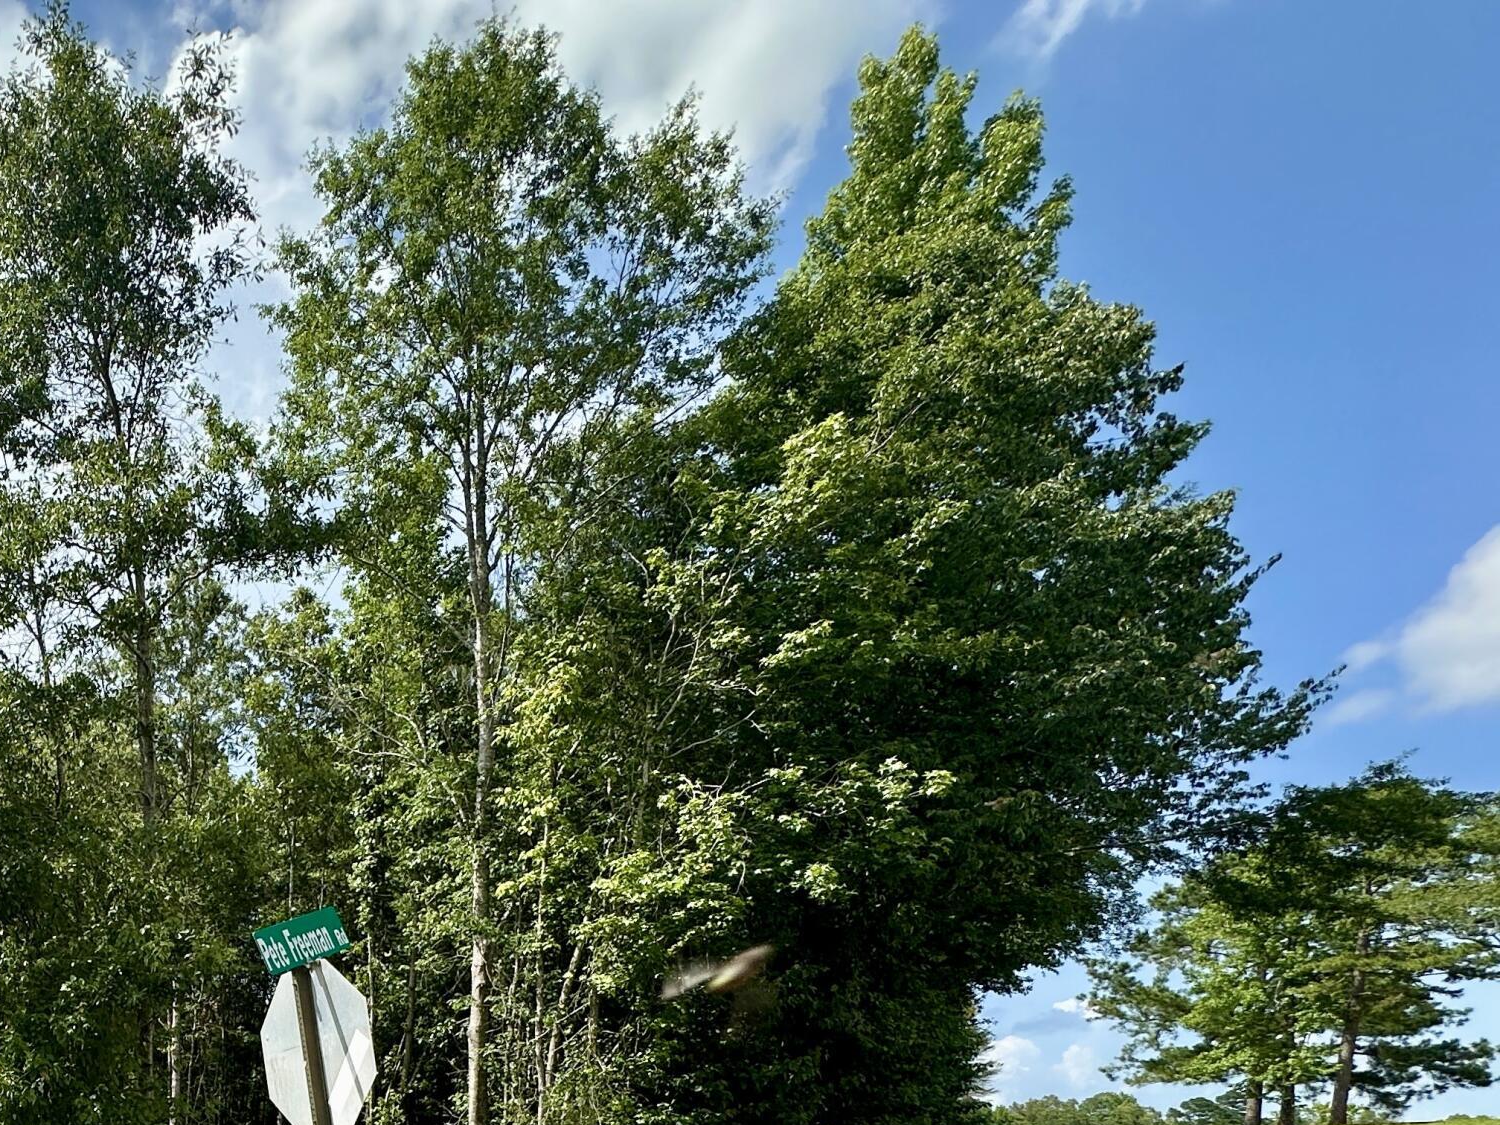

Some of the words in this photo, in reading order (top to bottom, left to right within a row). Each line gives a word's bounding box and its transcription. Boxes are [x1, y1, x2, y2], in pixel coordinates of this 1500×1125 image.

[257, 937, 290, 971] Pete
[282, 927, 335, 962] Freeman
[334, 927, 349, 946] Rd
